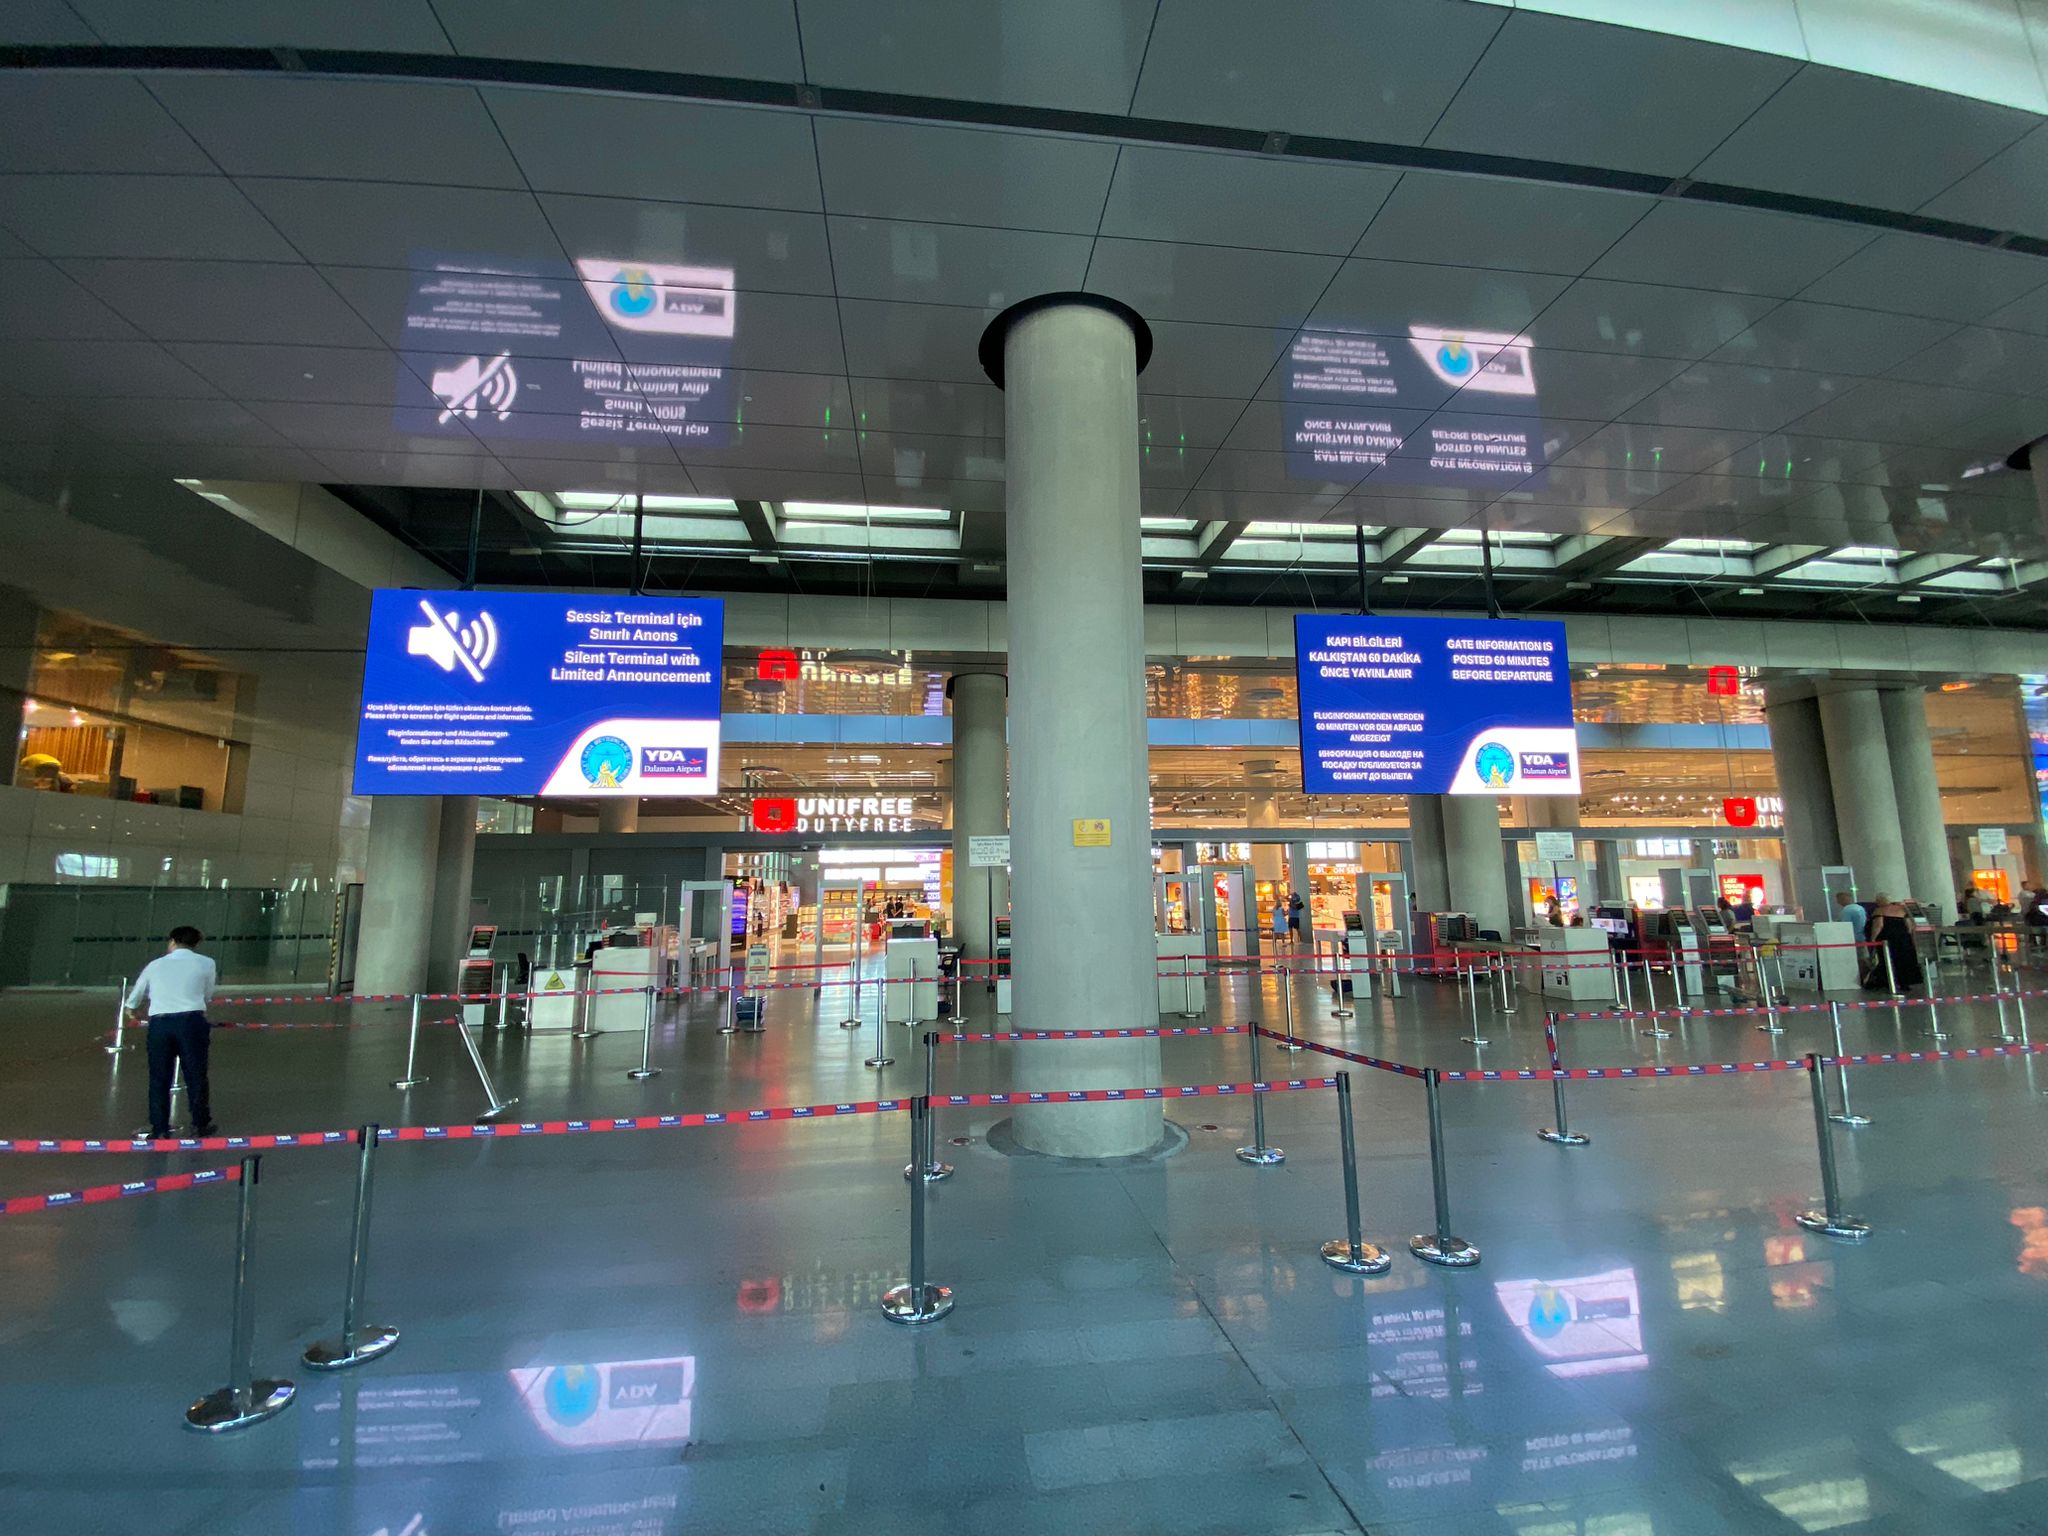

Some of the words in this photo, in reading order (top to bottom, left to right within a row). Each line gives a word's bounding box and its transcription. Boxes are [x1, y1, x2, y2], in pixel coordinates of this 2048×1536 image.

[566, 611, 611, 623] Sessiz
[615, 612, 674, 625] Terminal
[677, 613, 702, 628] için
[590, 628, 630, 640] Sınırlı
[633, 629, 678, 642] Anons
[1327, 637, 1351, 646] KAPI
[1353, 636, 1402, 647] BİLGİLERİ
[1447, 639, 1474, 649] GATE
[1476, 640, 1541, 650] INFORMATION
[1543, 642, 1553, 651] IS
[564, 651, 605, 664] Silent
[608, 652, 667, 665] Terminal
[671, 653, 700, 666] with
[1309, 652, 1366, 664] KALKIŞTAN
[1369, 653, 1380, 662] 60
[1382, 652, 1421, 663] DAKİKA
[1453, 655, 1492, 664] POSTED
[1494, 656, 1505, 665] 60
[1507, 656, 1549, 666] MINUTES
[552, 668, 603, 681] Limited
[607, 669, 711, 683] Announcement
[1320, 666, 1349, 677] ÖNCE
[1351, 668, 1412, 678] YAYINLANIR
[1452, 670, 1492, 680] BEFORE
[1494, 671, 1553, 681] DEPARTURE
[1360, 723, 1375, 731] VOR
[645, 750, 685, 762] YDA
[1522, 755, 1553, 765] YDA
[676, 765, 701, 774] Airport
[798, 798, 913, 815] UNIFREE
[797, 818, 912, 832] DUTYFREE
[123, 1182, 145, 1190] YDA
[48, 1192, 71, 1200] YDA
